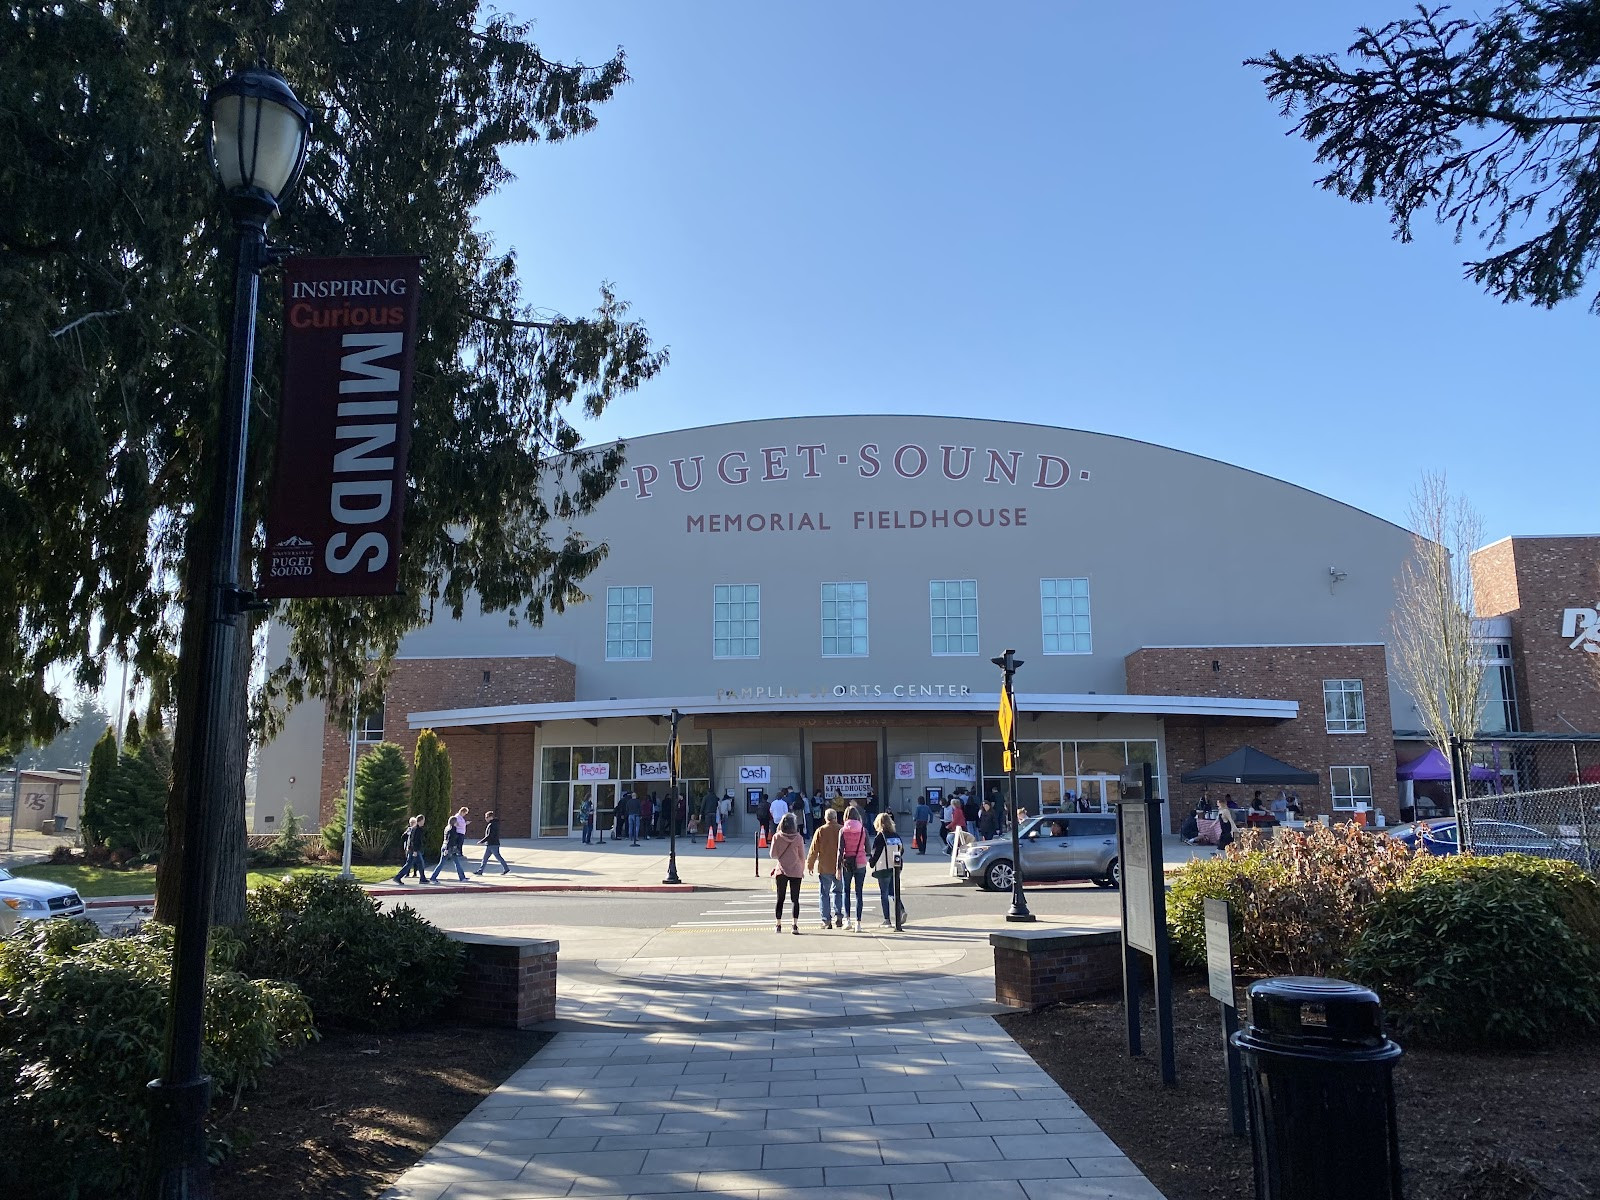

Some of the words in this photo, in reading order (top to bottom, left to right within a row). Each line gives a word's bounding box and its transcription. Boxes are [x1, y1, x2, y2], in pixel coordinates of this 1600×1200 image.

[292, 279, 406, 299] INSPIRING
[290, 301, 404, 328] Curious
[325, 332, 403, 573] MINDS
[632, 443, 827, 499] PUGET
[858, 443, 1071, 489] SOUND
[686, 512, 831, 533] MEMORIAL
[853, 508, 1027, 530] FIELDHOUSE
[272, 556, 314, 567] PUGET
[270, 566, 312, 577] SOUND
[717, 685, 799, 700] PAMPLIN
[893, 684, 970, 698] CENTER
[740, 766, 766, 779] Cash
[827, 775, 870, 785] MARKET
